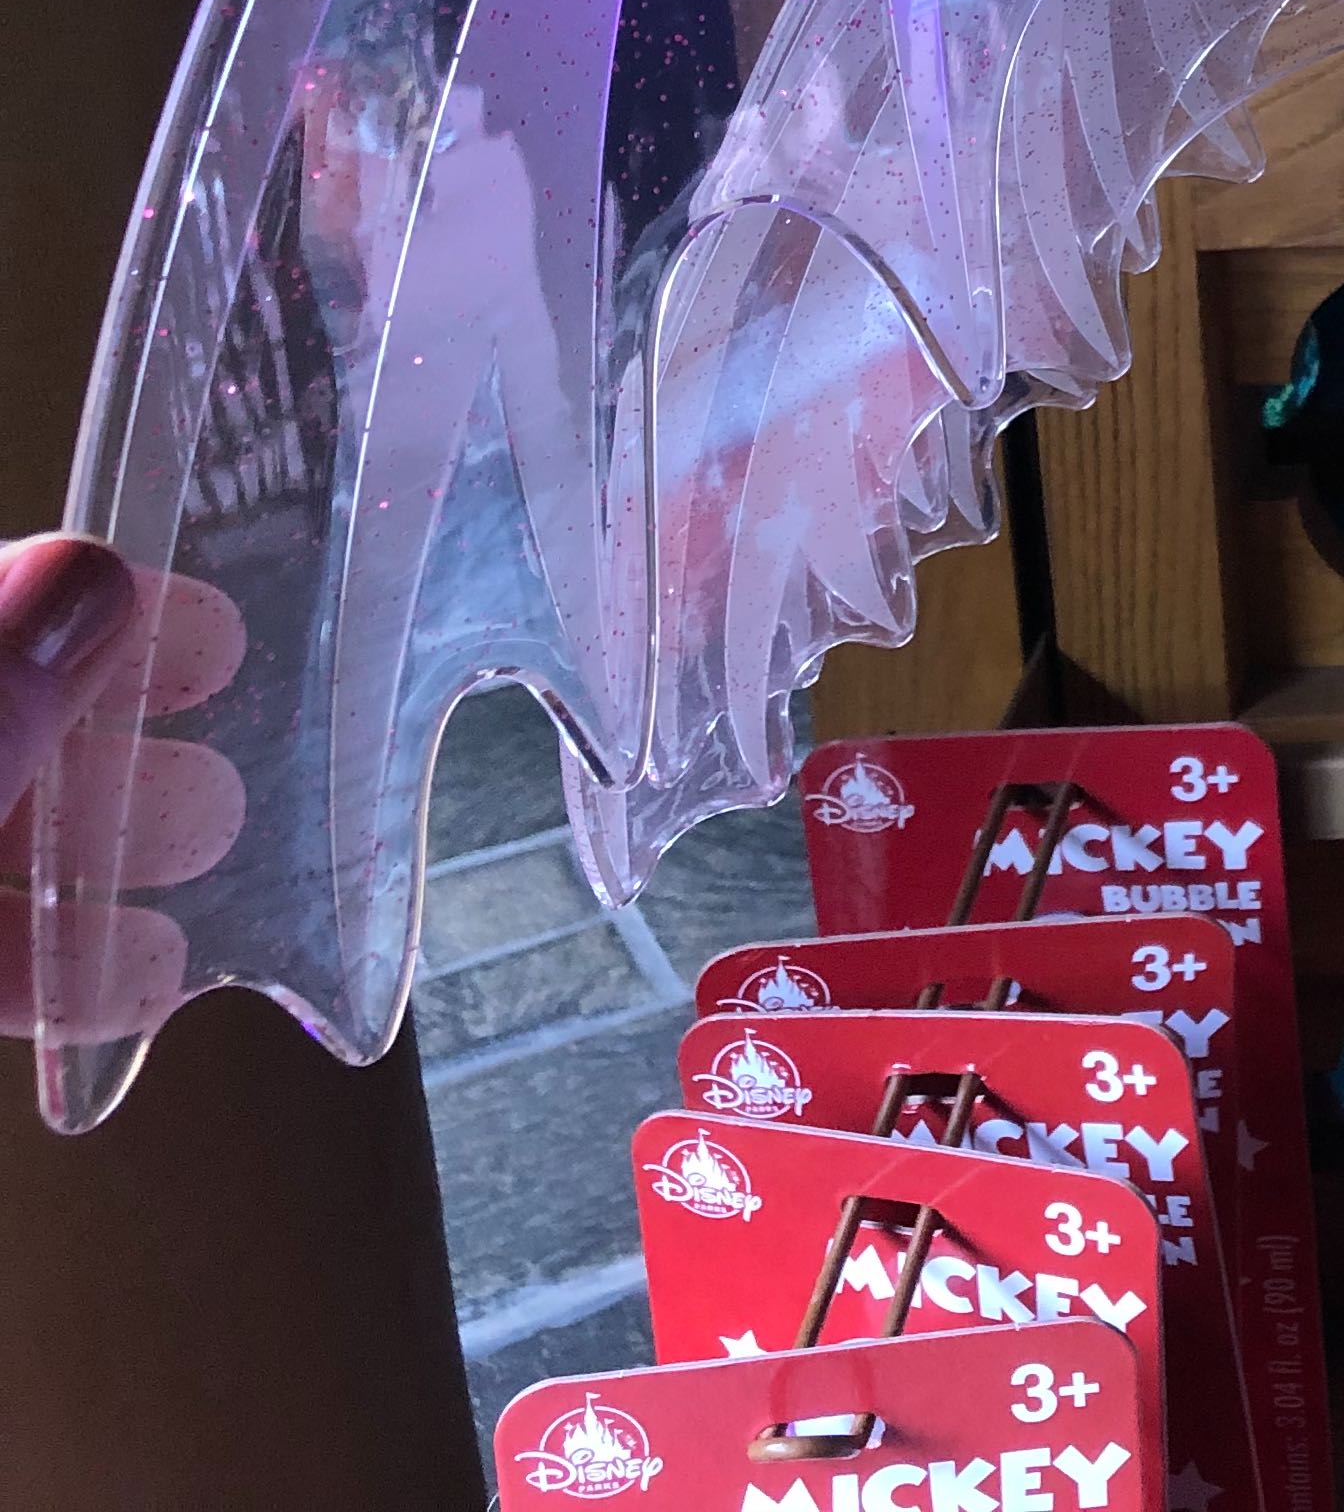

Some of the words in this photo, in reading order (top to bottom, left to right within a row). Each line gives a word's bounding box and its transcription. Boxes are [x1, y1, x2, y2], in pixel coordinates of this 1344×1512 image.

[1169, 756, 1240, 802] 3+
[1101, 881, 1262, 914] BUBBLE
[1131, 945, 1208, 992] 3+
[1082, 1050, 1157, 1103] 3+
[1044, 1202, 1121, 1257] 3+
[1010, 1363, 1100, 1423] 3+
[740, 1441, 1132, 1512] MICKEY
